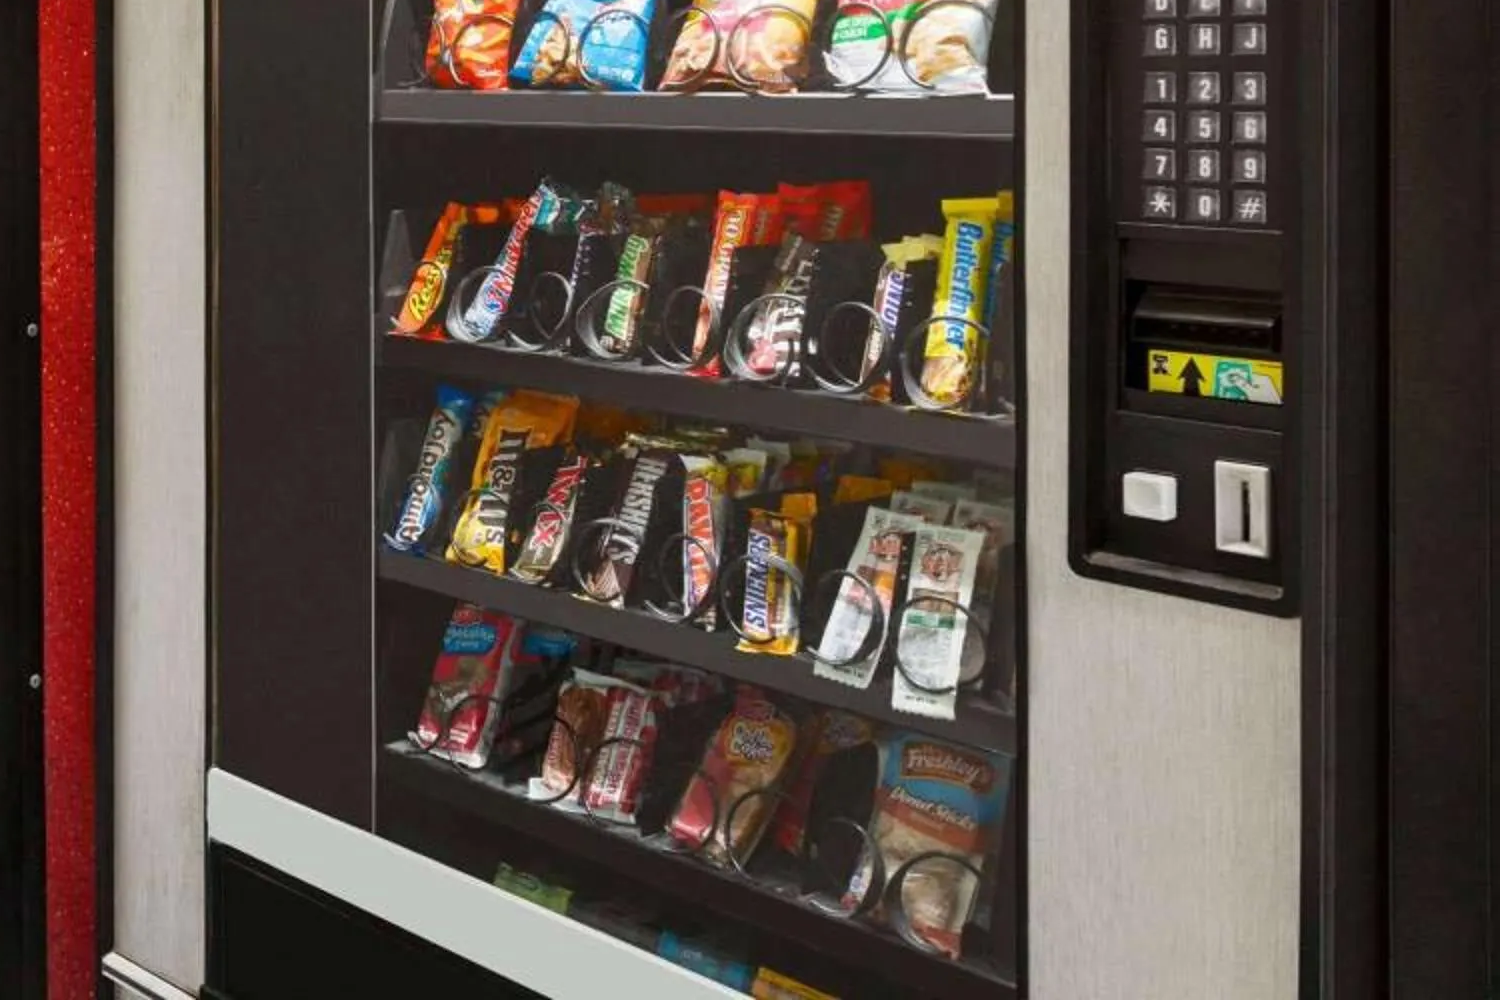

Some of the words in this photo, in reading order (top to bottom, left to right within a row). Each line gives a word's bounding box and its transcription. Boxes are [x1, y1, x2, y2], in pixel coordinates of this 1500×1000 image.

[1155, 27, 1169, 50] G
[1199, 27, 1213, 49] H
[1244, 27, 1257, 49] J
[1156, 78, 1167, 99] 1
[1199, 78, 1212, 100] 2
[1243, 78, 1257, 100] 3
[1153, 117, 1167, 137] 4
[1199, 117, 1211, 138] 5
[1244, 117, 1257, 139] 6
[1155, 155, 1168, 175] 7
[1199, 155, 1211, 178] 8
[1243, 157, 1257, 179] 9
[1198, 195, 1212, 217] 0
[1238, 197, 1261, 219] #
